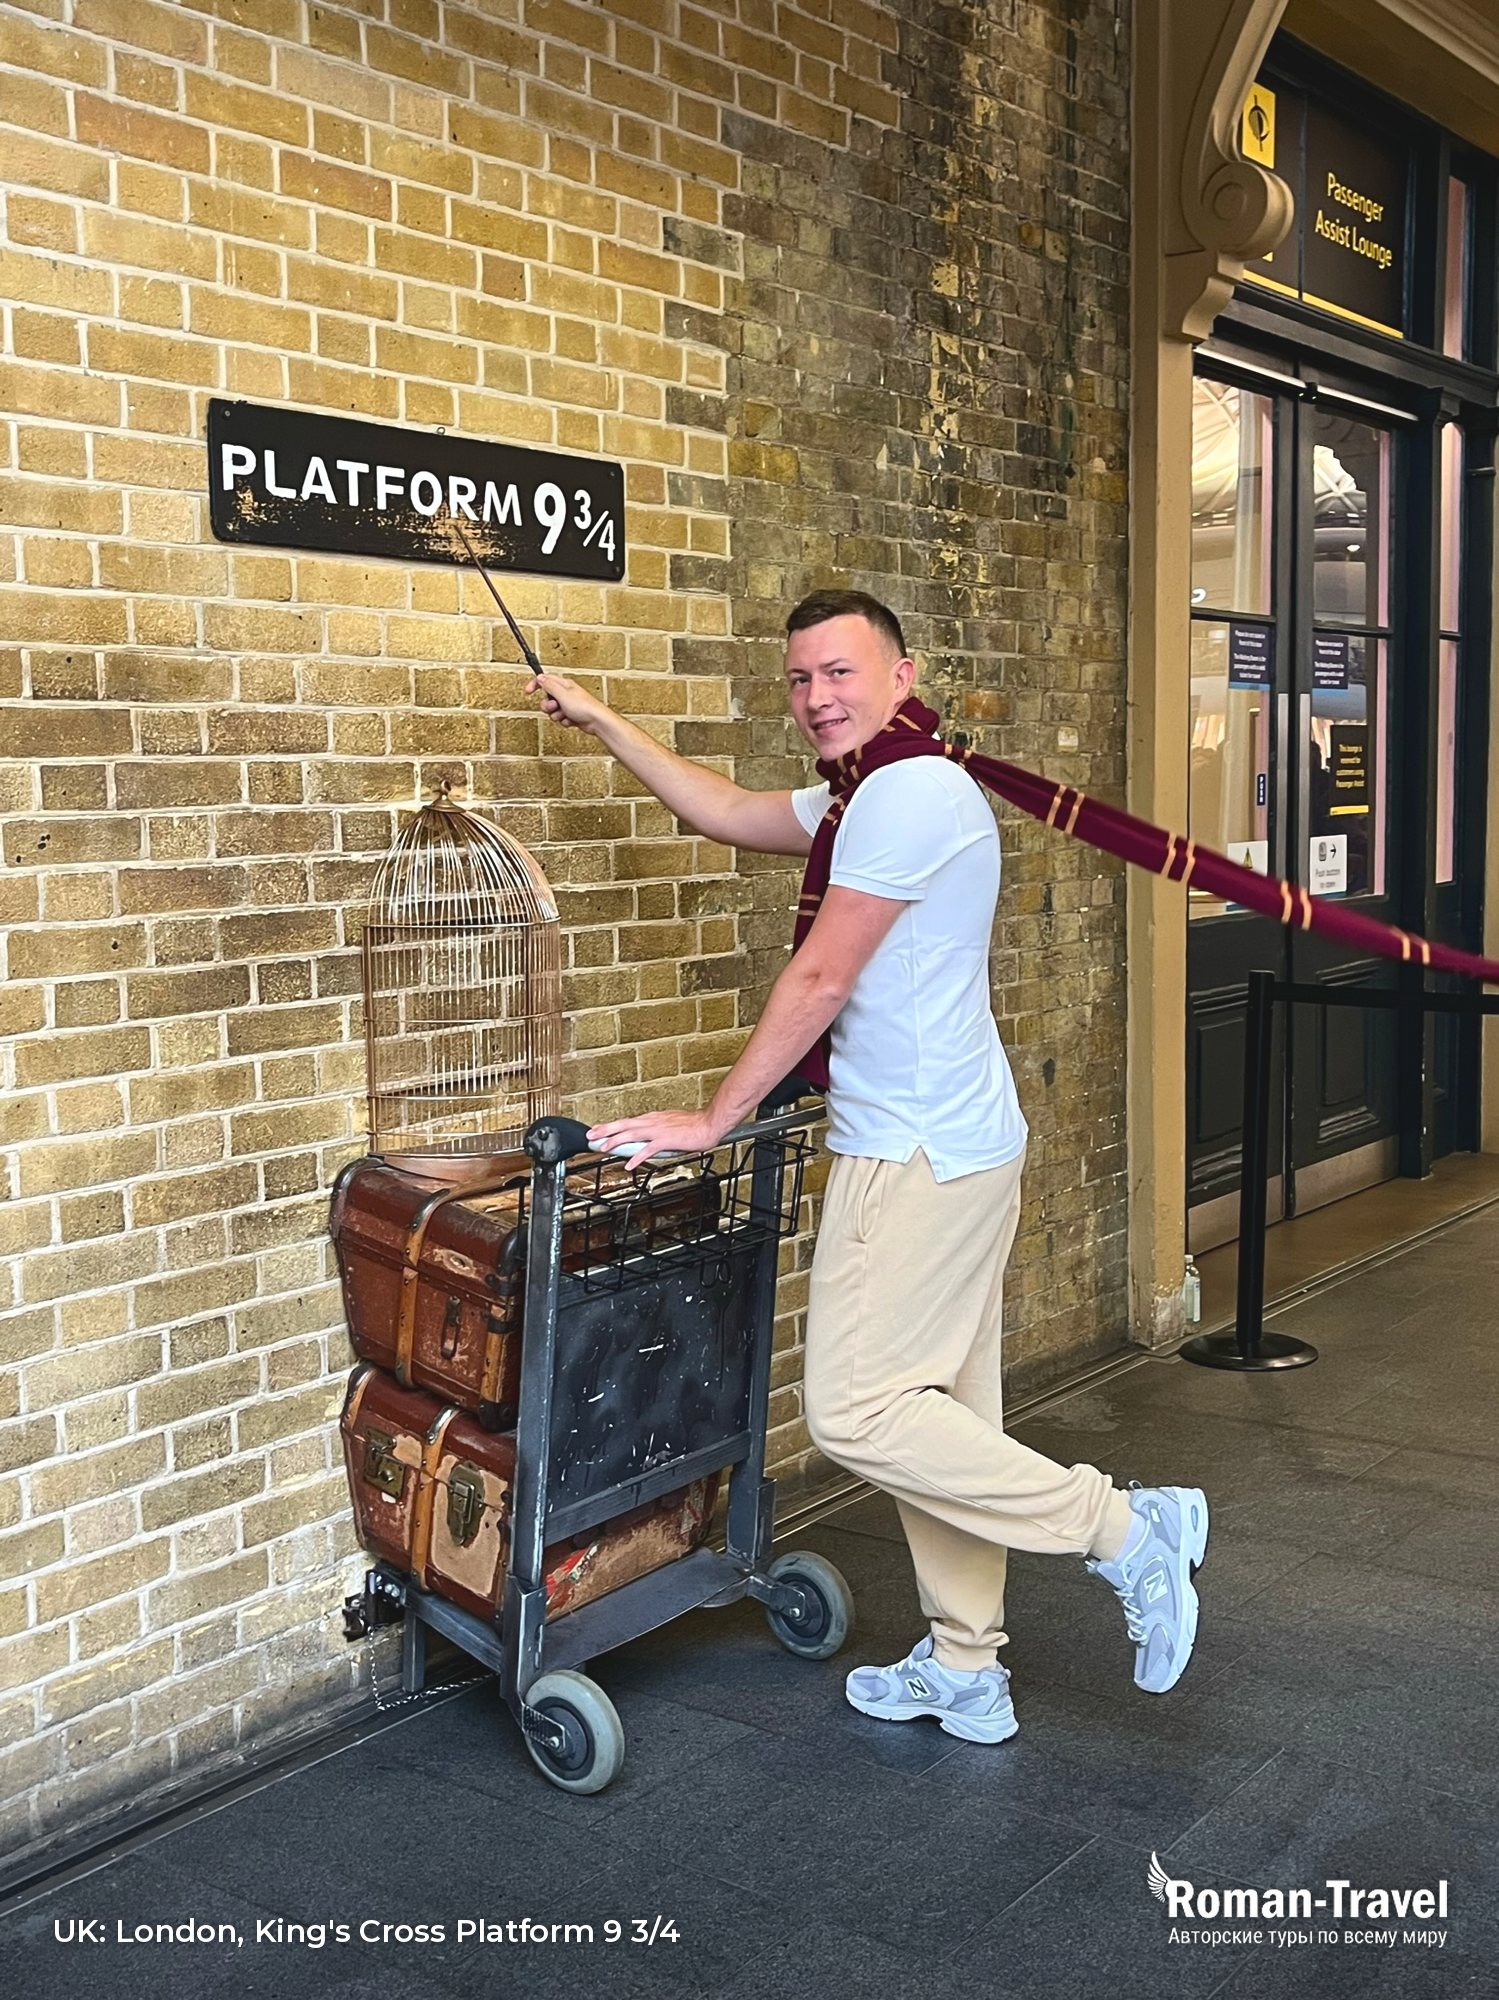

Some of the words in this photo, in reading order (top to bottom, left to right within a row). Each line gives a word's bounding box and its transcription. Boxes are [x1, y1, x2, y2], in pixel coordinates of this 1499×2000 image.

[1327, 171, 1384, 223] Passenger
[1315, 209, 1350, 248] Assist
[1352, 226, 1392, 269] Lounge
[221, 443, 523, 527] PLATFORM
[905, 1677, 932, 1699] N
